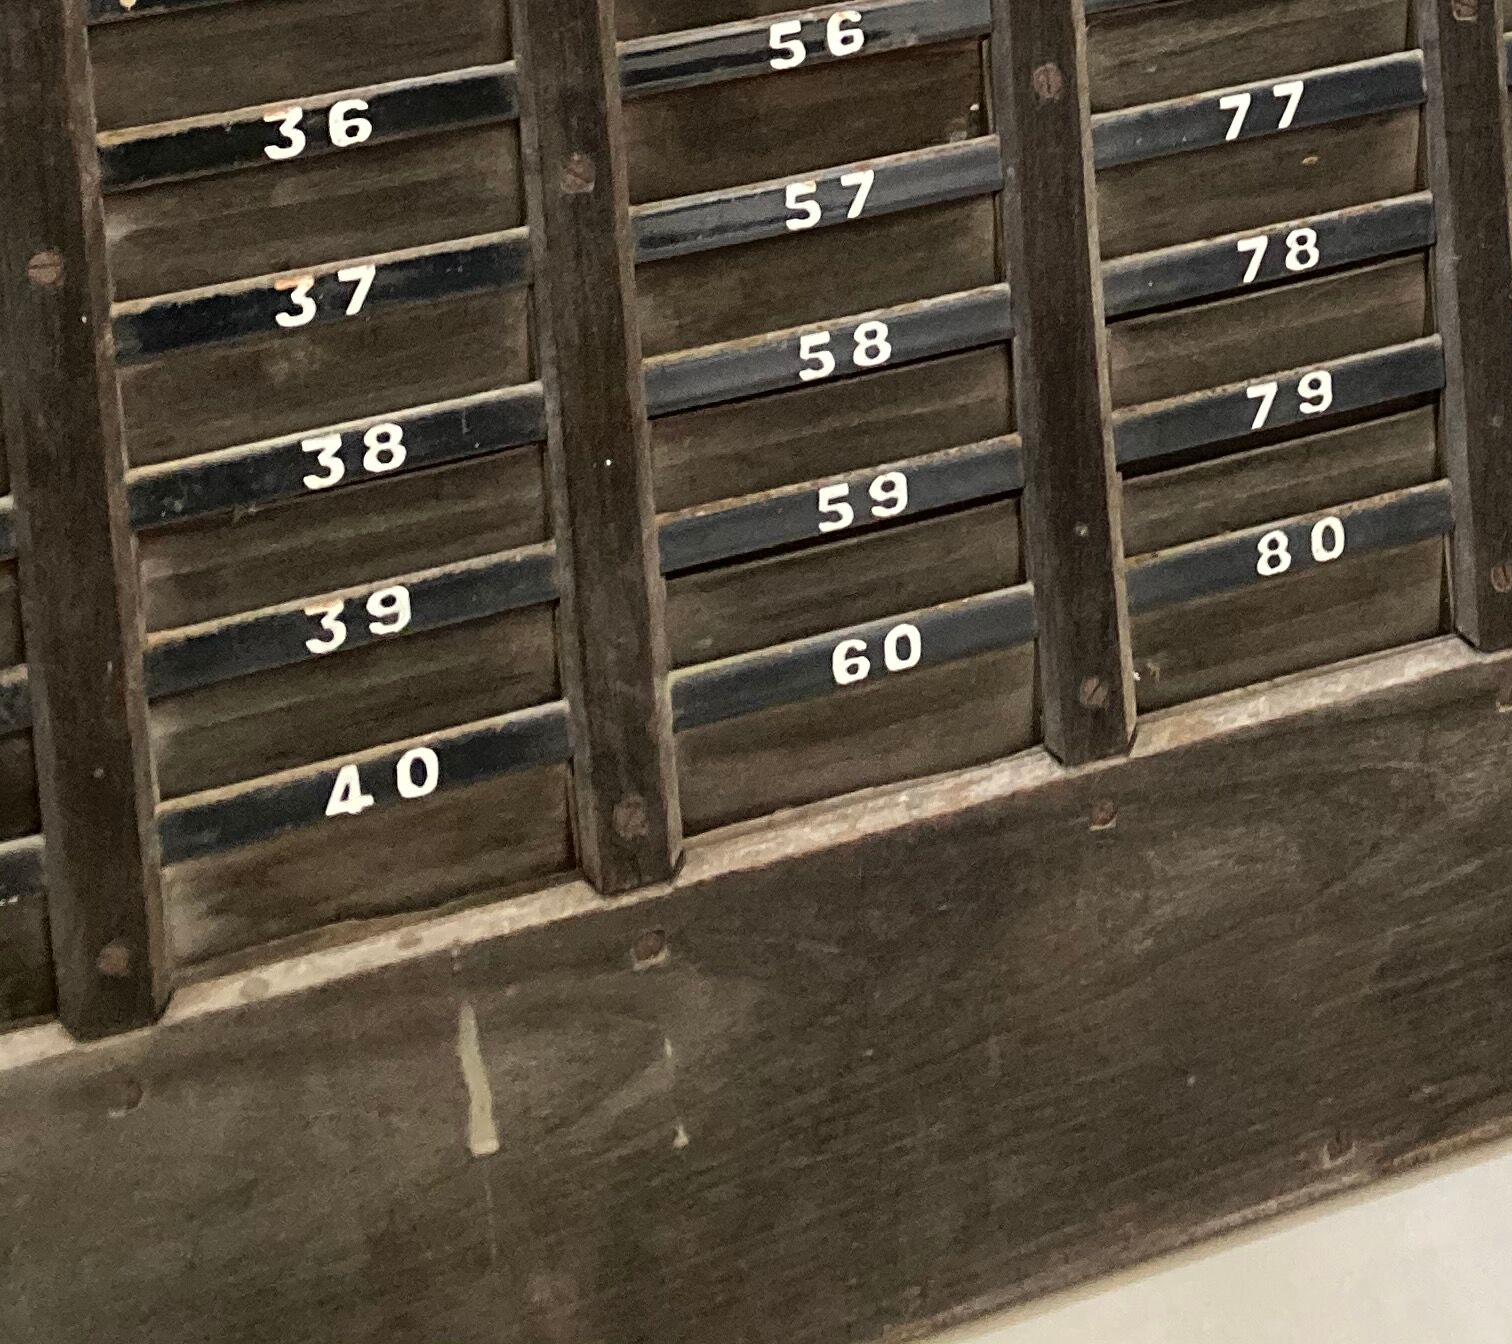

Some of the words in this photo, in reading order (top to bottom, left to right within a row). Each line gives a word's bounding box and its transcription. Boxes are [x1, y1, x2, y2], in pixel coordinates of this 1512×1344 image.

[770, 4, 871, 69] 56
[264, 99, 372, 159] 36
[786, 169, 874, 230] 57
[1238, 228, 1319, 283] 78
[275, 262, 375, 327] 37
[1247, 370, 1332, 429] 79
[302, 423, 406, 489] 38
[819, 472, 907, 532] 59
[1257, 516, 1344, 575] 80
[833, 624, 921, 684] 60
[326, 747, 438, 816] 40
